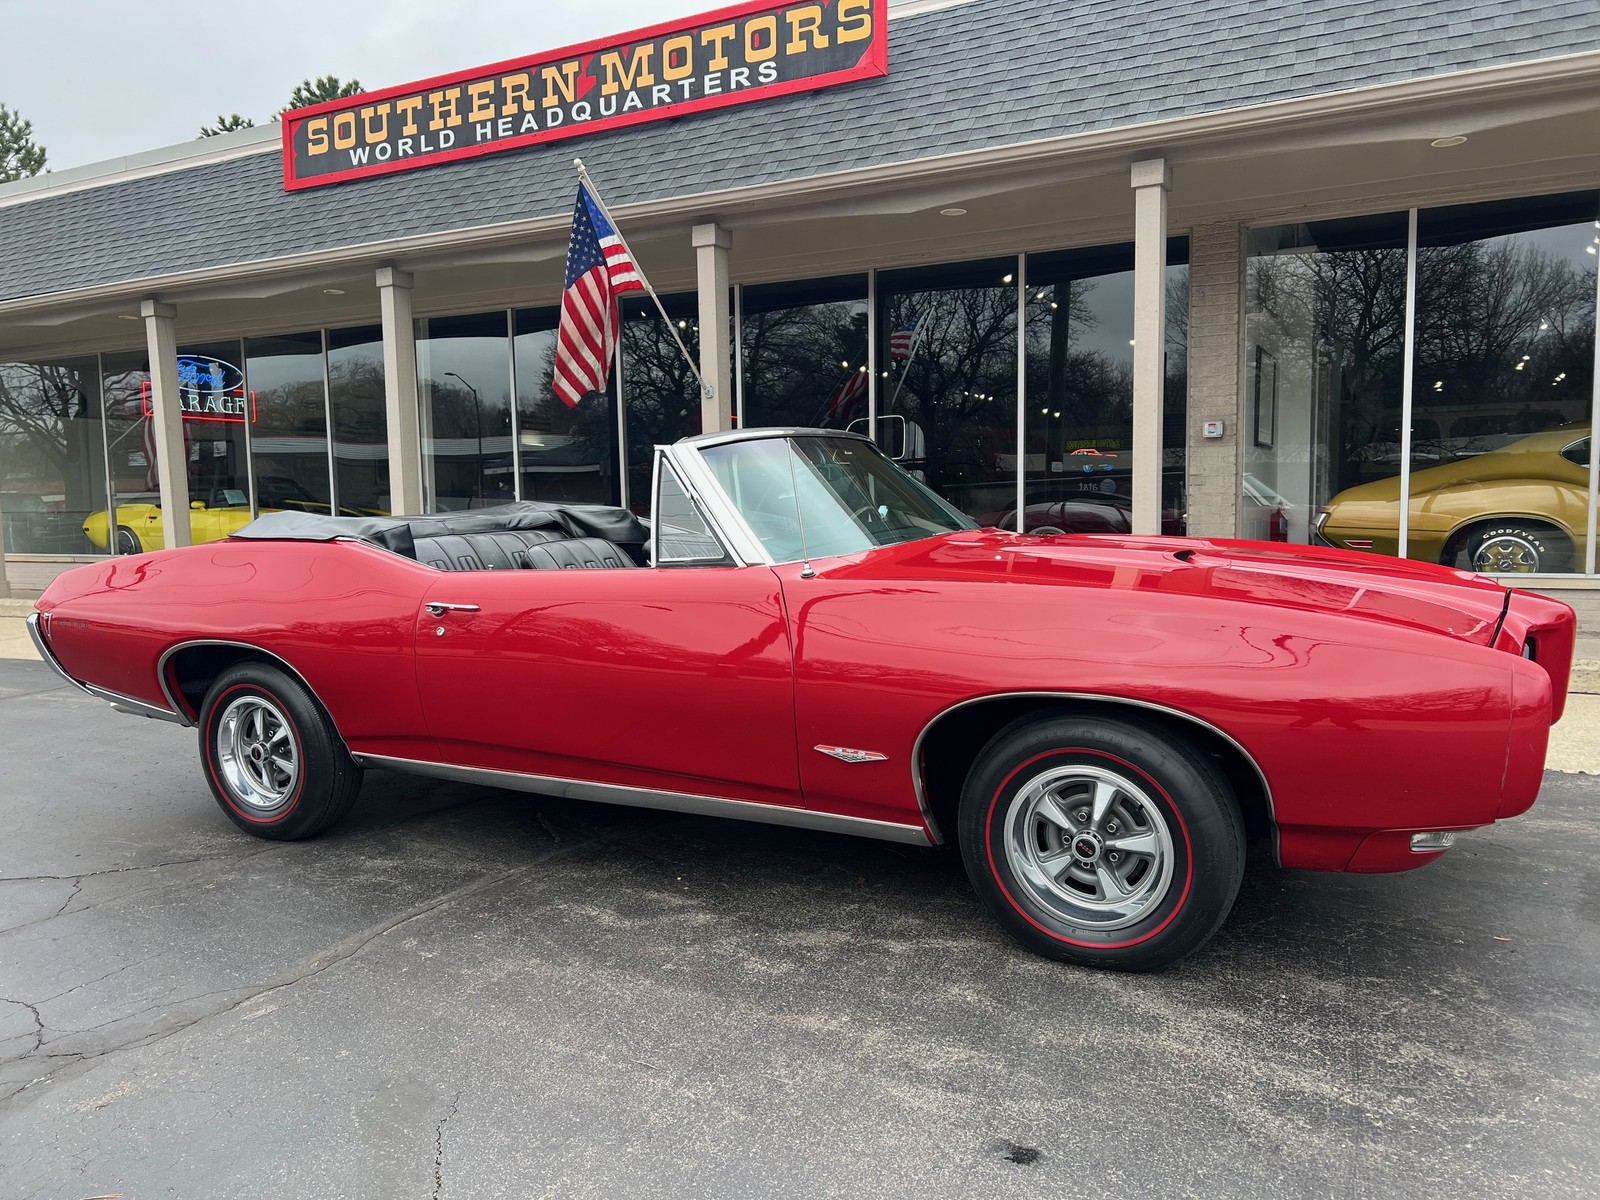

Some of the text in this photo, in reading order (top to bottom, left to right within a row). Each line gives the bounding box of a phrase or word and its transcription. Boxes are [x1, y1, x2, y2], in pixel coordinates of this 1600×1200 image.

[307, 0, 872, 156] SOUTHERN MOTORS
[349, 61, 778, 166] WORLD HEADQUARTERS
[176, 359, 226, 387] Ford
[180, 394, 245, 414] RAGE
[1482, 529, 1545, 552] GOODYEAR
